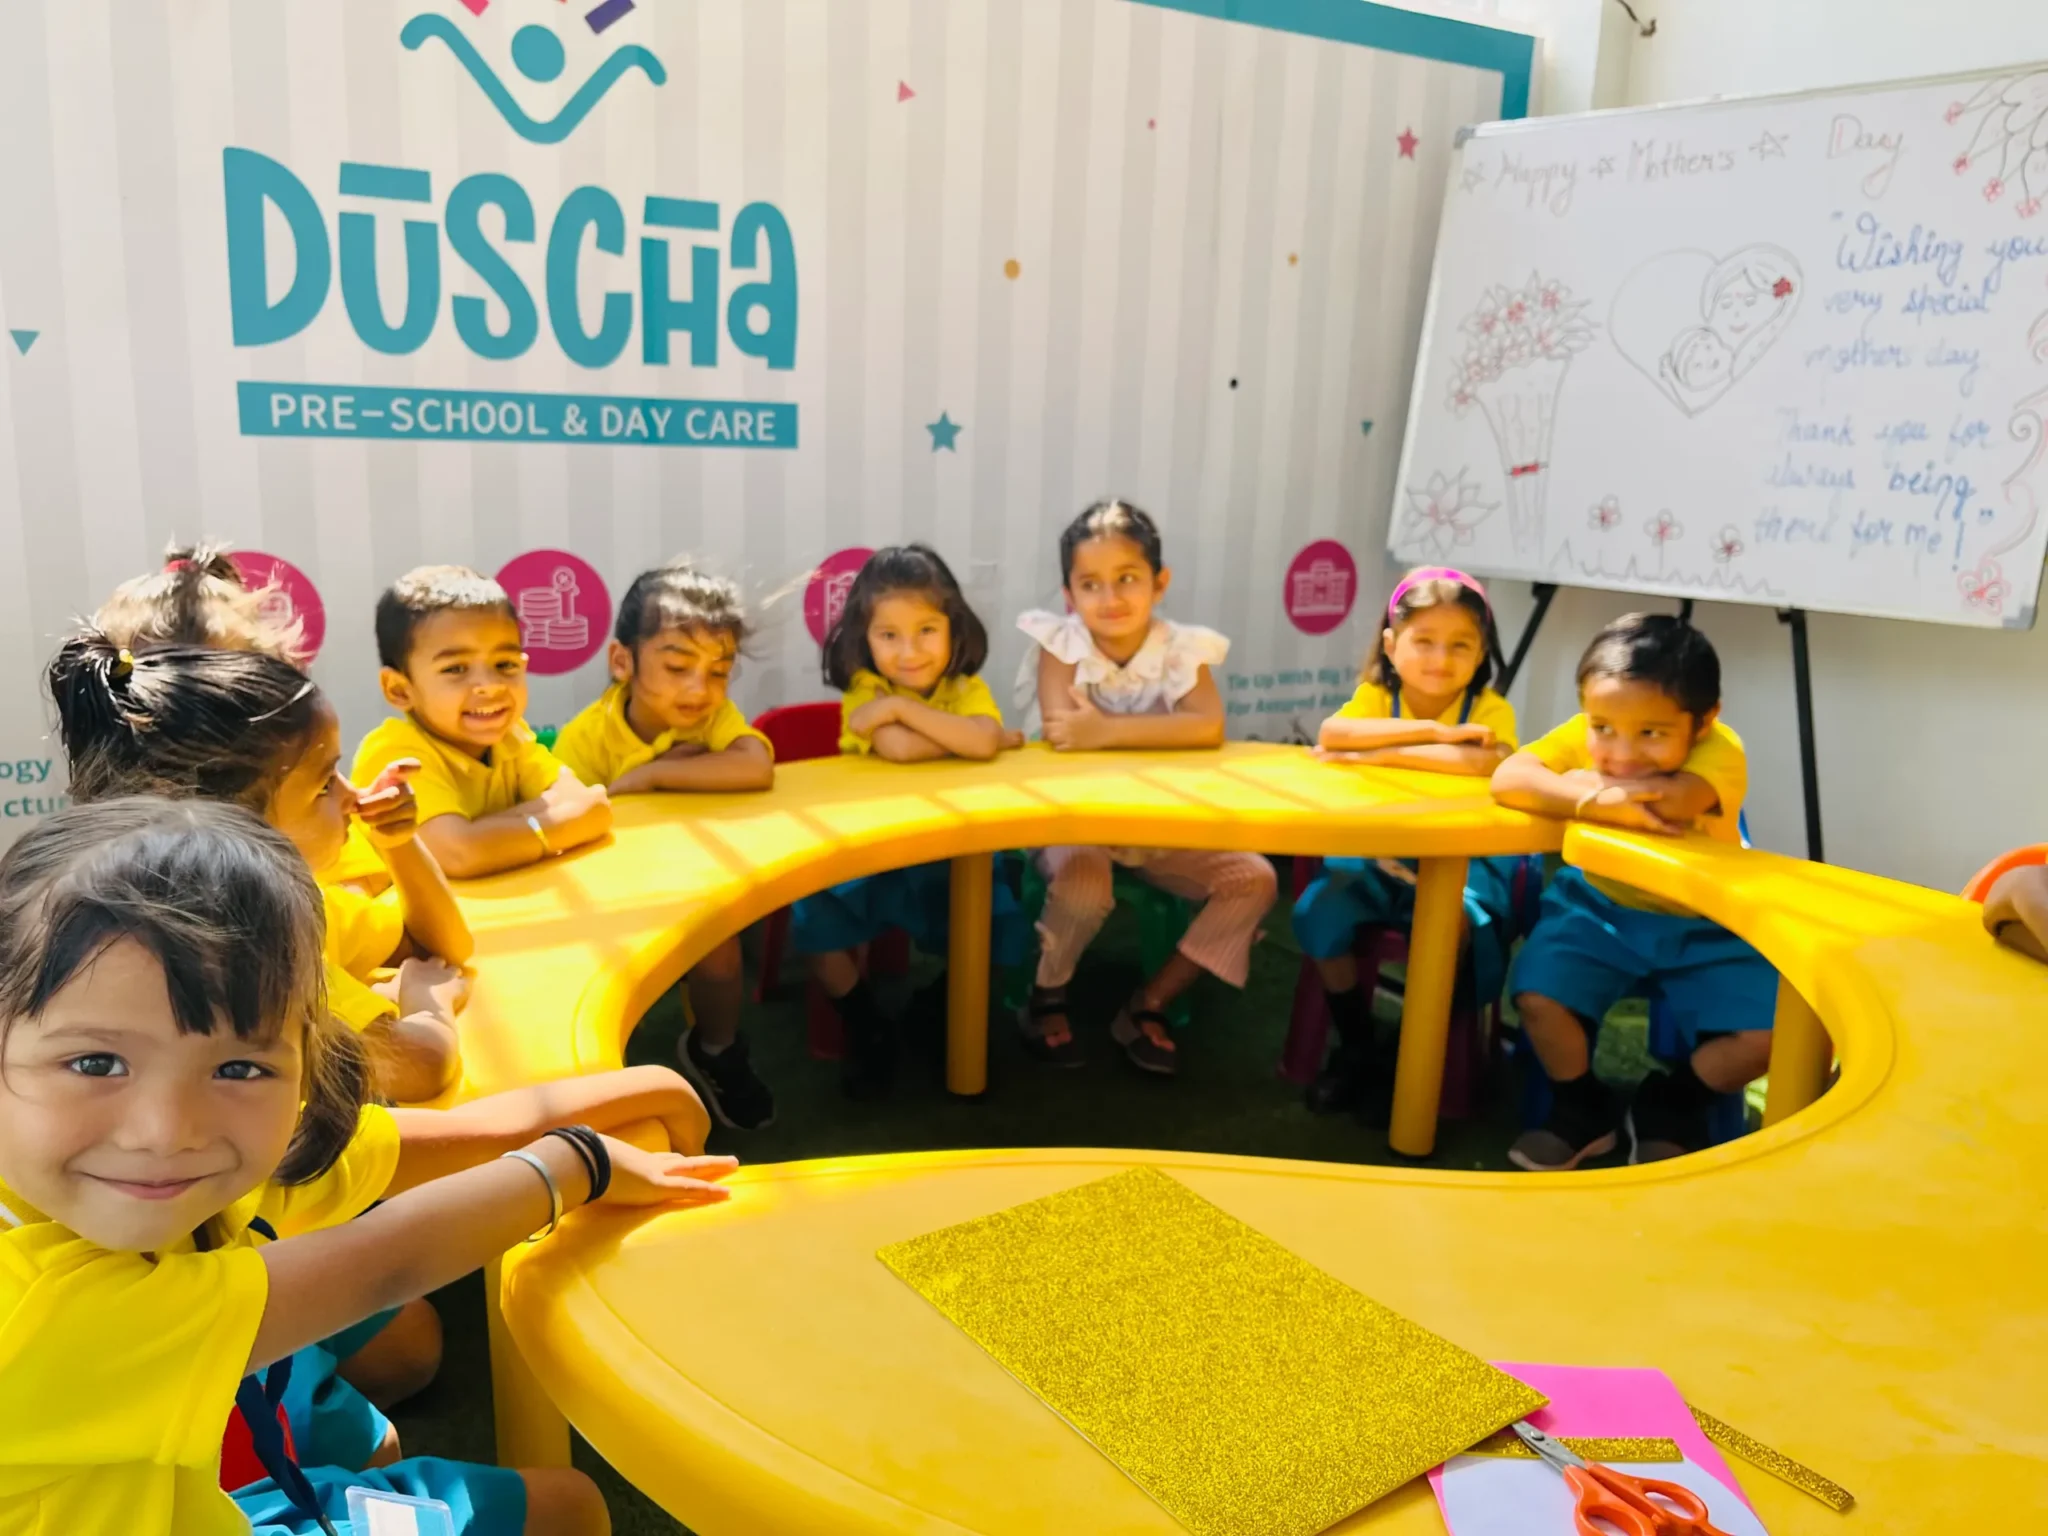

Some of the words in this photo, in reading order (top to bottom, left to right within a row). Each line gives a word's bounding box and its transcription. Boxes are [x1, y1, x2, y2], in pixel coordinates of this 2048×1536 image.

[1493, 149, 1578, 217] Happy
[1826, 112, 1904, 200] Day
[1984, 235, 2048, 294] you
[1823, 288, 1884, 340] very
[1901, 274, 1991, 326] special
[1924, 336, 1981, 399] day
[270, 392, 549, 436] PRE-SCHOOL
[562, 404, 588, 437] &
[602, 405, 672, 440] DAY
[685, 407, 776, 442] CARE
[1775, 407, 1856, 446] Thank
[1873, 418, 1930, 468] you
[1944, 412, 1993, 465] for
[1887, 459, 1978, 522] being
[1753, 504, 1833, 546] there
[1848, 507, 1894, 561] for
